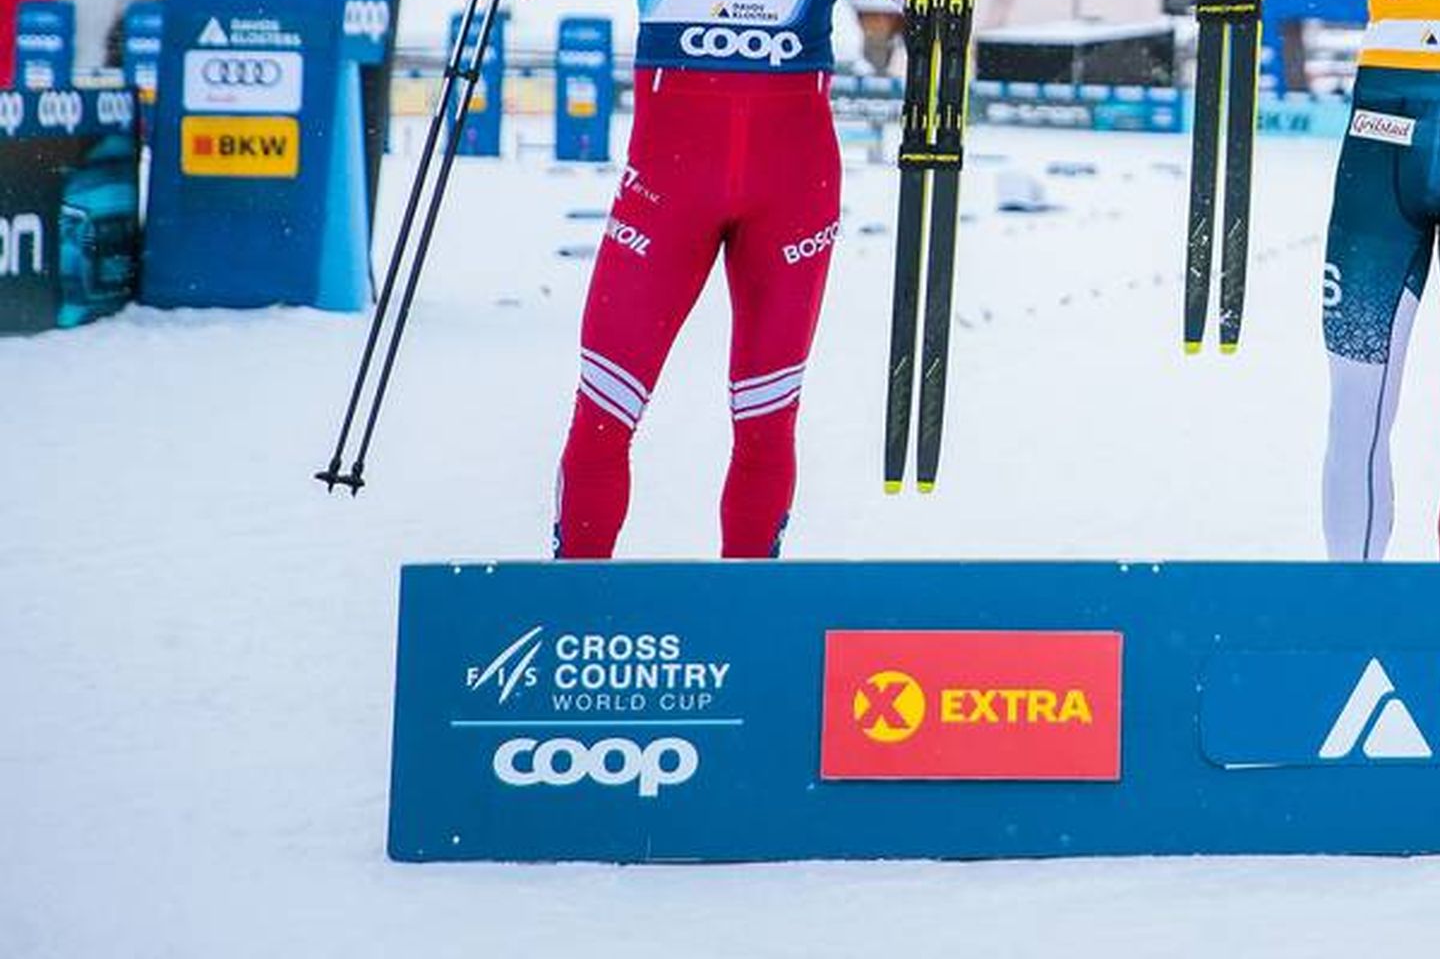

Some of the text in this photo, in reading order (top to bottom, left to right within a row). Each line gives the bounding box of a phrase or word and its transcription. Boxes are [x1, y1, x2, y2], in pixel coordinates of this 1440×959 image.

[680, 26, 803, 67] coop
[218, 135, 287, 157] BKW
[555, 635, 681, 660] CROSS
[554, 663, 731, 689] COUNTRY
[552, 694, 713, 711] WORLD CUP
[939, 690, 1093, 723] EXTRA
[493, 737, 699, 797] coop
